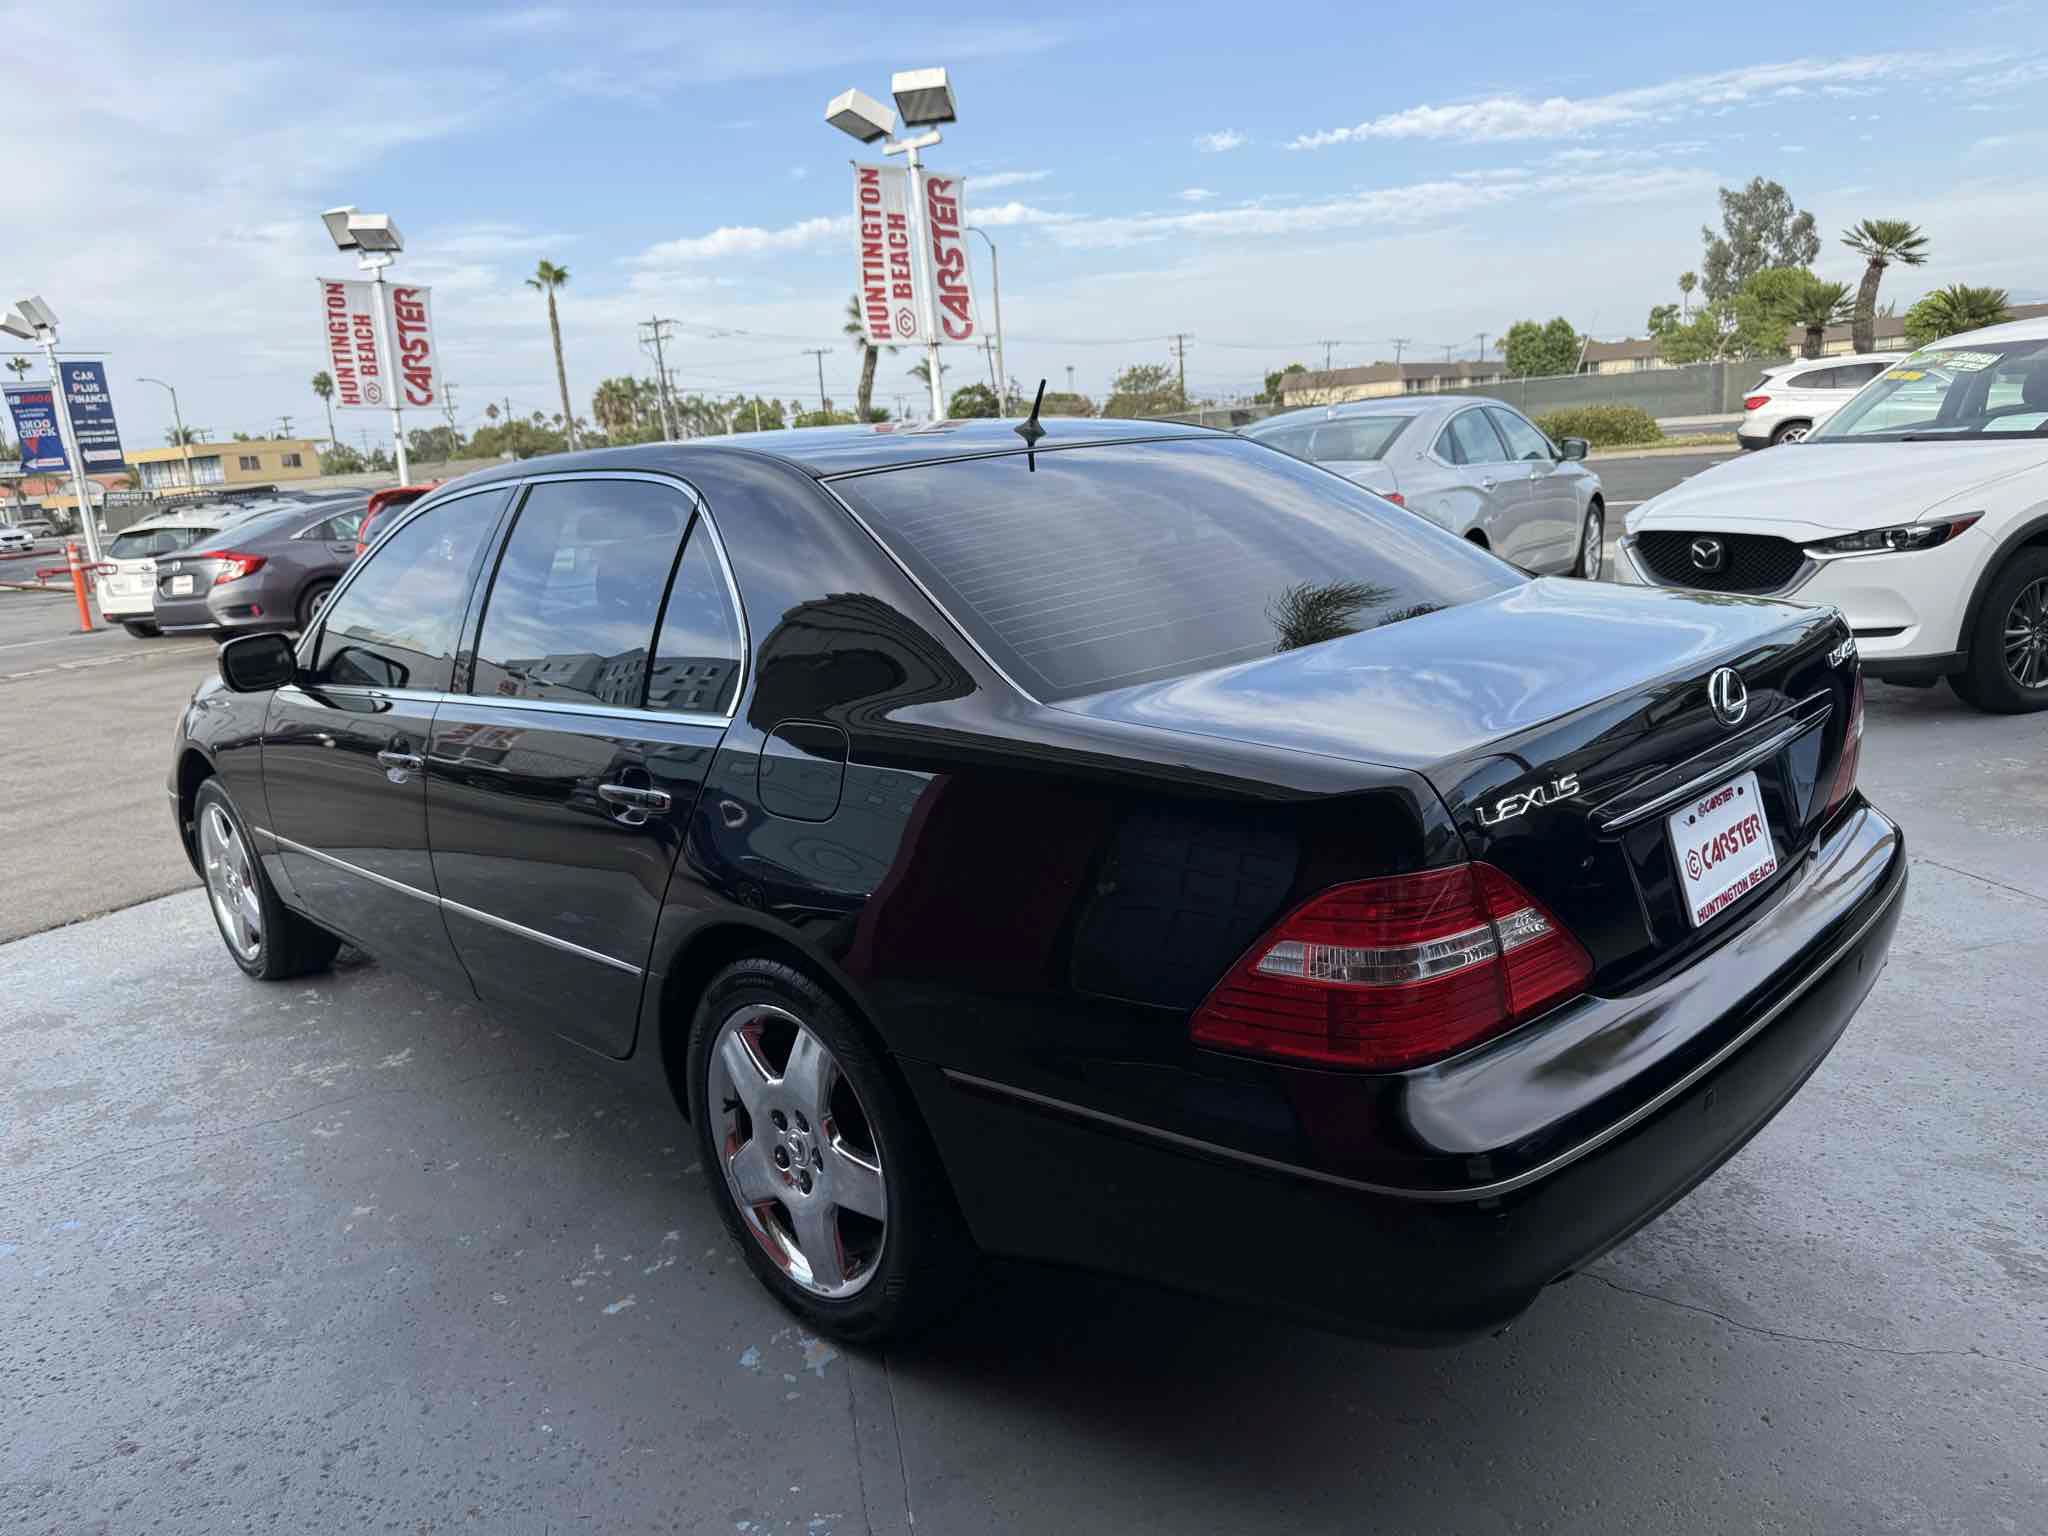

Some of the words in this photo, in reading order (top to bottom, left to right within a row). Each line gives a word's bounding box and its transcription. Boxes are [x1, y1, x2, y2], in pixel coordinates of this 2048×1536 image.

[859, 167, 892, 341] HUNTINGTON
[886, 212, 913, 300] BEACH
[926, 176, 974, 341] CARSTER
[325, 282, 361, 405] HUNTINGTON
[352, 313, 379, 377] BEACH
[393, 287, 433, 406] CARSTER
[73, 383, 99, 393] PLUS
[1474, 773, 1580, 826] LEXUS
[1702, 813, 1762, 870] CARSTER
[1697, 877, 1750, 923] HUNTINGTON
[1748, 858, 1776, 887] BEACH
